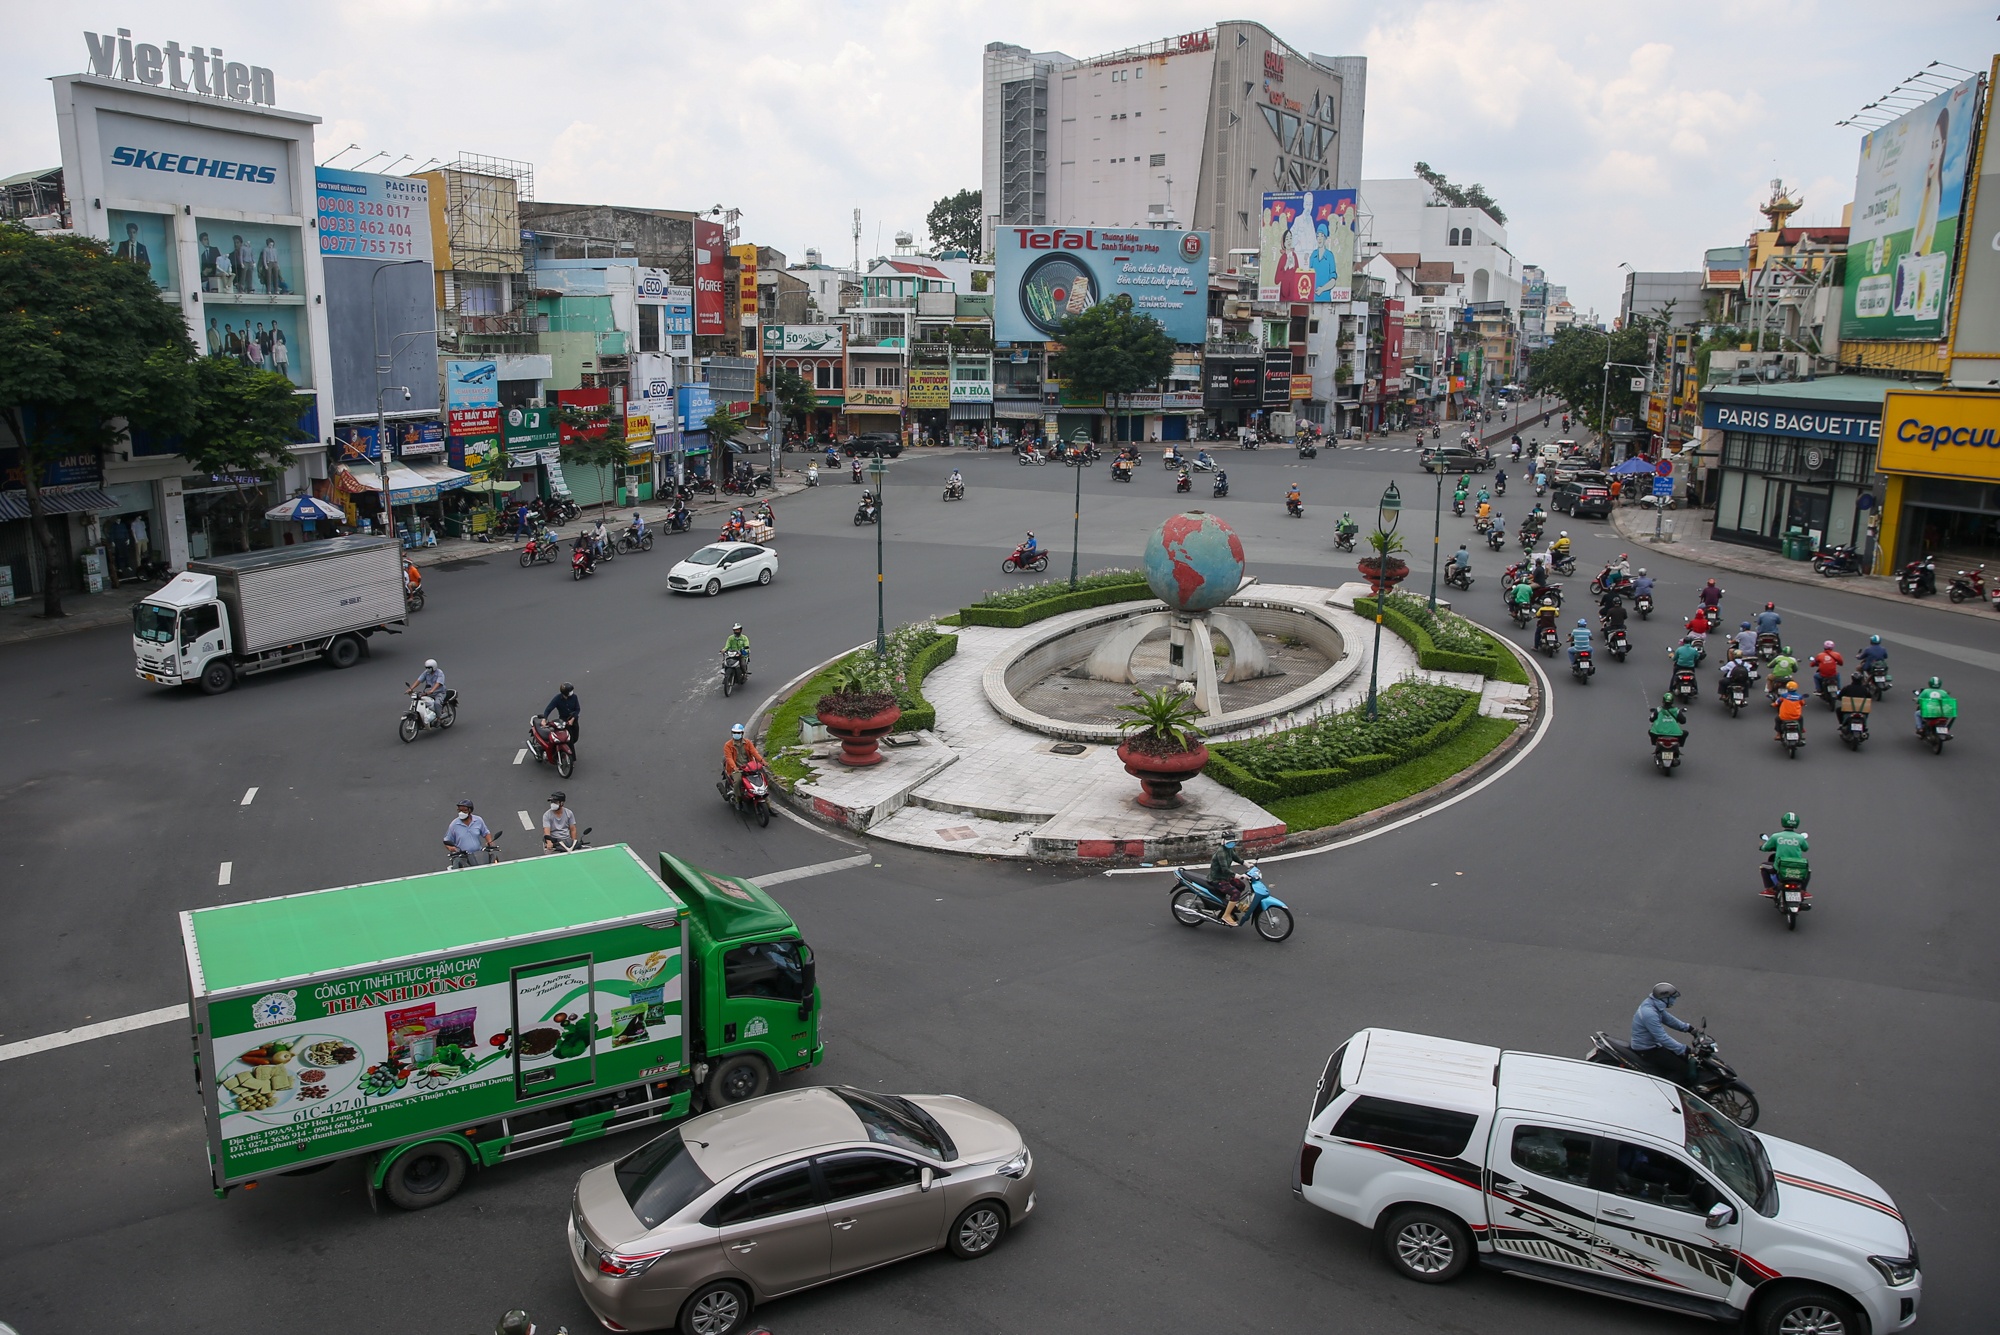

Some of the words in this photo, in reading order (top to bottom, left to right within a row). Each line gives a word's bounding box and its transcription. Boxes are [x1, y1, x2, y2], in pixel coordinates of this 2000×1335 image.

[1180, 32, 1209, 48] GALA
[1264, 50, 1284, 74] GALA
[111, 146, 276, 184] SKECHERS
[386, 181, 427, 193] PACIFIC
[386, 194, 428, 202] OUTDOOR
[318, 196, 354, 214] 0908
[358, 201, 384, 216] 328
[386, 204, 410, 218] 017
[320, 216, 356, 232] 0933
[360, 220, 384, 234] 462
[388, 224, 412, 237] 404
[1013, 229, 1098, 250] Tefal
[1102, 234, 1124, 242] Thương
[322, 236, 356, 251] 0977
[360, 239, 386, 253] 755
[390, 242, 412, 254] 751
[1144, 244, 1160, 253] Pháp
[1173, 266, 1189, 278] gian
[646, 280, 660, 292] ECO
[704, 280, 722, 292] GREE
[786, 334, 808, 343] 50%
[652, 384, 666, 394] ECO
[952, 386, 967, 395] AN
[969, 384, 990, 395] HÒA
[864, 394, 894, 404] iPhone
[464, 410, 480, 420] MÁY
[482, 410, 497, 418] BAY
[1718, 408, 1769, 428] PARIS
[1774, 413, 1882, 438] BAGUETTE
[376, 432, 390, 444] 31
[1897, 418, 2000, 450] Capcuu
[78, 453, 96, 466] CÚC
[1776, 837, 1800, 846] Grab
[315, 984, 346, 1000] CÔNG
[347, 980, 362, 992] TY
[362, 973, 394, 991] TNHH
[394, 967, 425, 987] THỰC
[426, 960, 454, 980] PHẨM
[455, 956, 482, 974] CHAY
[565, 978, 587, 988] Chay
[636, 975, 654, 984] food
[322, 989, 410, 1016] THANH
[410, 973, 478, 999] DŨNG
[519, 984, 542, 995] Dinh
[256, 1020, 278, 1028] THANH
[229, 1137, 245, 1146] Địa
[246, 1134, 262, 1144] chỉ:
[296, 1122, 310, 1131] KP
[312, 1117, 329, 1127] Hòa
[364, 1106, 378, 1115] Lái
[404, 1097, 418, 1106] TX
[418, 1091, 444, 1102] Thuận
[469, 1080, 487, 1090] Bình
[488, 1076, 514, 1086] Dương
[293, 1096, 370, 1122] 61C-427.01
[248, 1138, 269, 1149] 0274
[270, 1134, 290, 1144] 3636
[291, 1130, 306, 1139] 914
[313, 1126, 333, 1135] 0904
[334, 1122, 348, 1131] 661
[350, 1117, 365, 1126] 914
